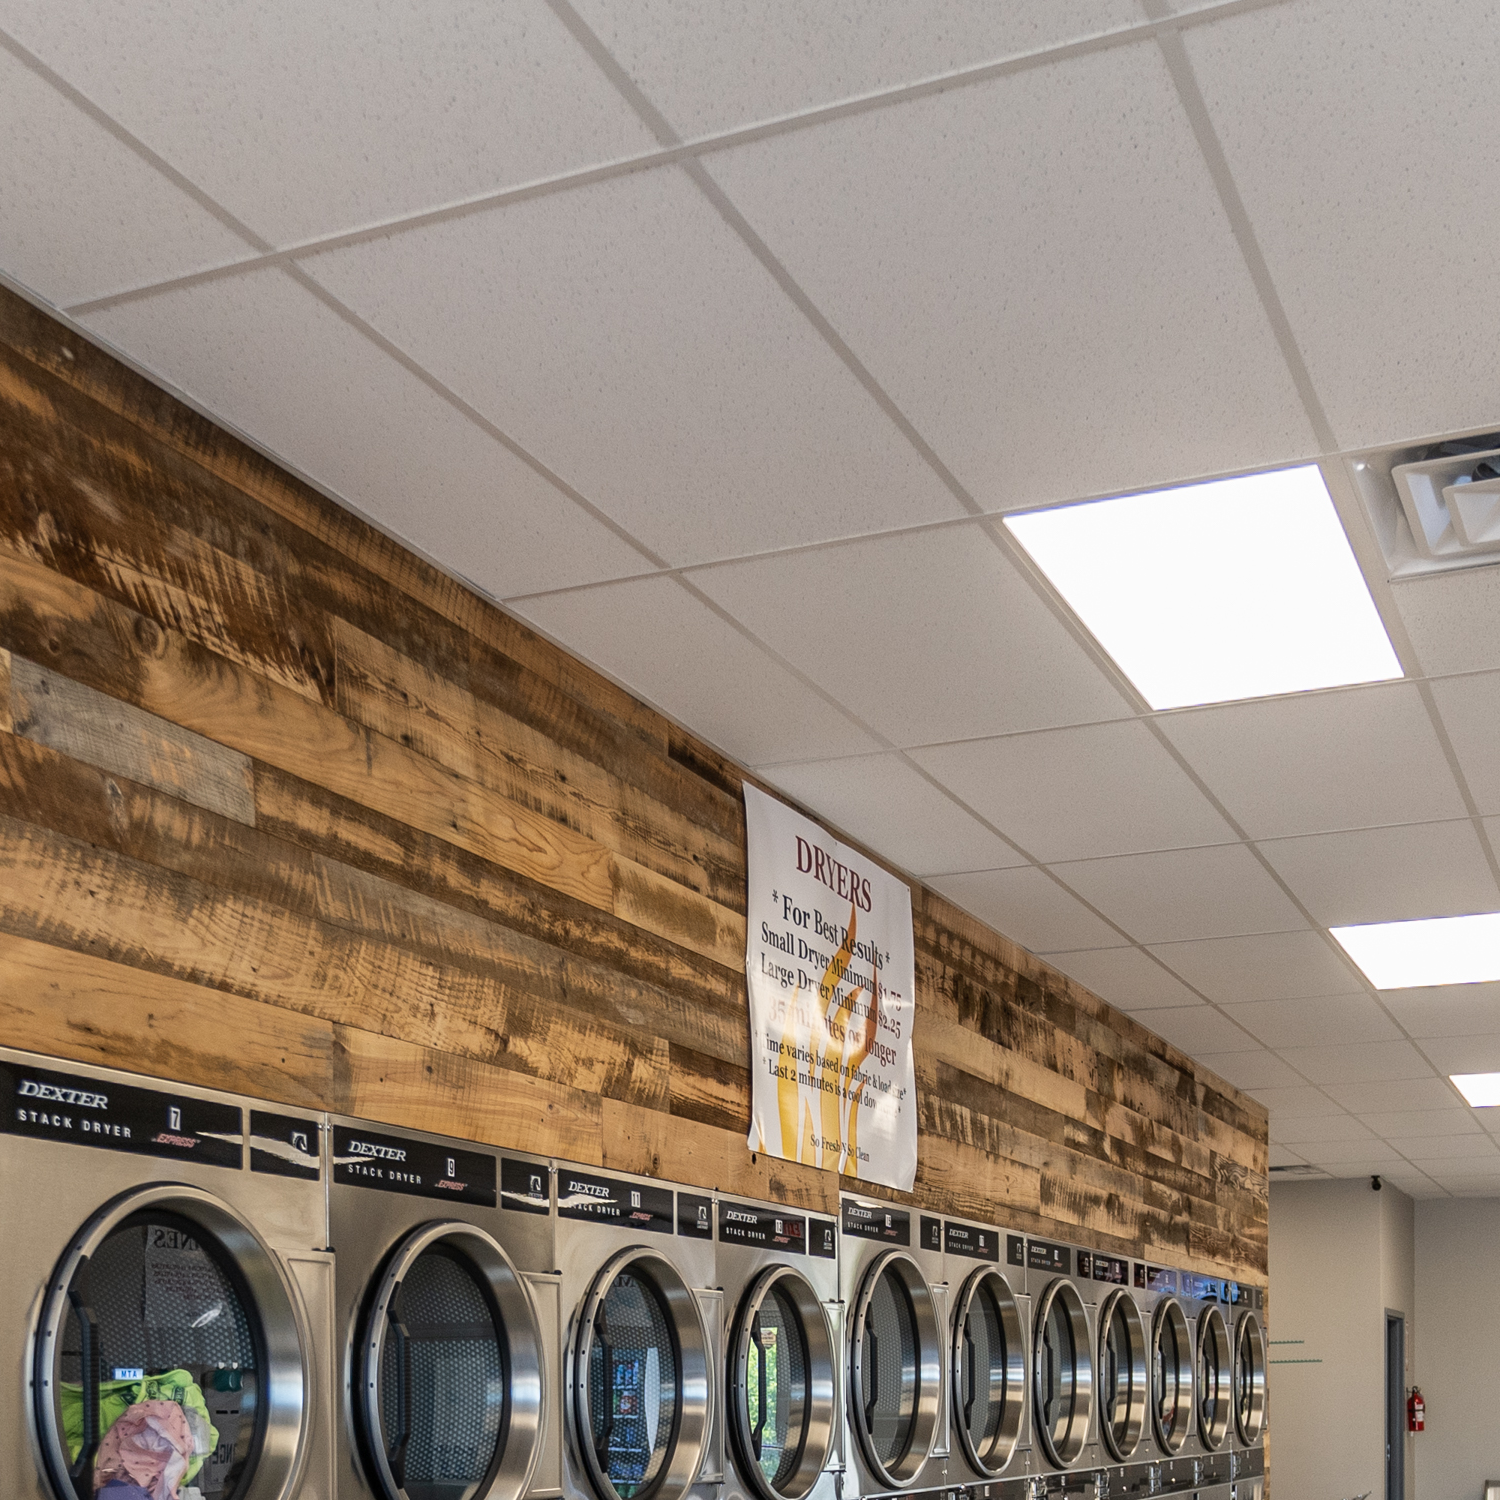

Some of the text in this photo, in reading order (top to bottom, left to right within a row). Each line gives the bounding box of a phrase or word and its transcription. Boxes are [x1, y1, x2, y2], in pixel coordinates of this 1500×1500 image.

[795, 835, 872, 913] DRYERS
[783, 894, 883, 970] For Best Results
[761, 921, 795, 956] Small
[798, 938, 830, 970] Dryer
[831, 954, 877, 996] Minimum
[760, 952, 794, 988] Large
[832, 984, 877, 1024] Minimum
[878, 1009, 901, 1040] $2.25
[865, 1030, 897, 1067] longer
[768, 1058, 791, 1080] Last
[790, 1069, 796, 1082] 2
[798, 1070, 833, 1093] minutes
[835, 1081, 841, 1096] is
[842, 1086, 847, 1097] a
[848, 1088, 863, 1104] cool
[786, 1044, 815, 1062] varies
[816, 1050, 839, 1073] based
[840, 1063, 850, 1077] on
[851, 1065, 872, 1085] fabric
[872, 1075, 878, 1089] &
[878, 1078, 891, 1092] load
[18, 1079, 109, 1109] DEXTER
[17, 1109, 132, 1138] STACK DRYER
[155, 1133, 196, 1148] EXPRESS
[348, 1140, 407, 1162] DEXTER
[810, 1133, 820, 1148] So
[821, 1136, 841, 1153] Fresh
[856, 1147, 870, 1162] Clean
[348, 1164, 422, 1185] STACK DRYER
[568, 1181, 610, 1197] DEXTER
[596, 1205, 621, 1216] DRYER
[726, 1210, 758, 1224] DEXTER
[726, 1227, 745, 1237] STACK
